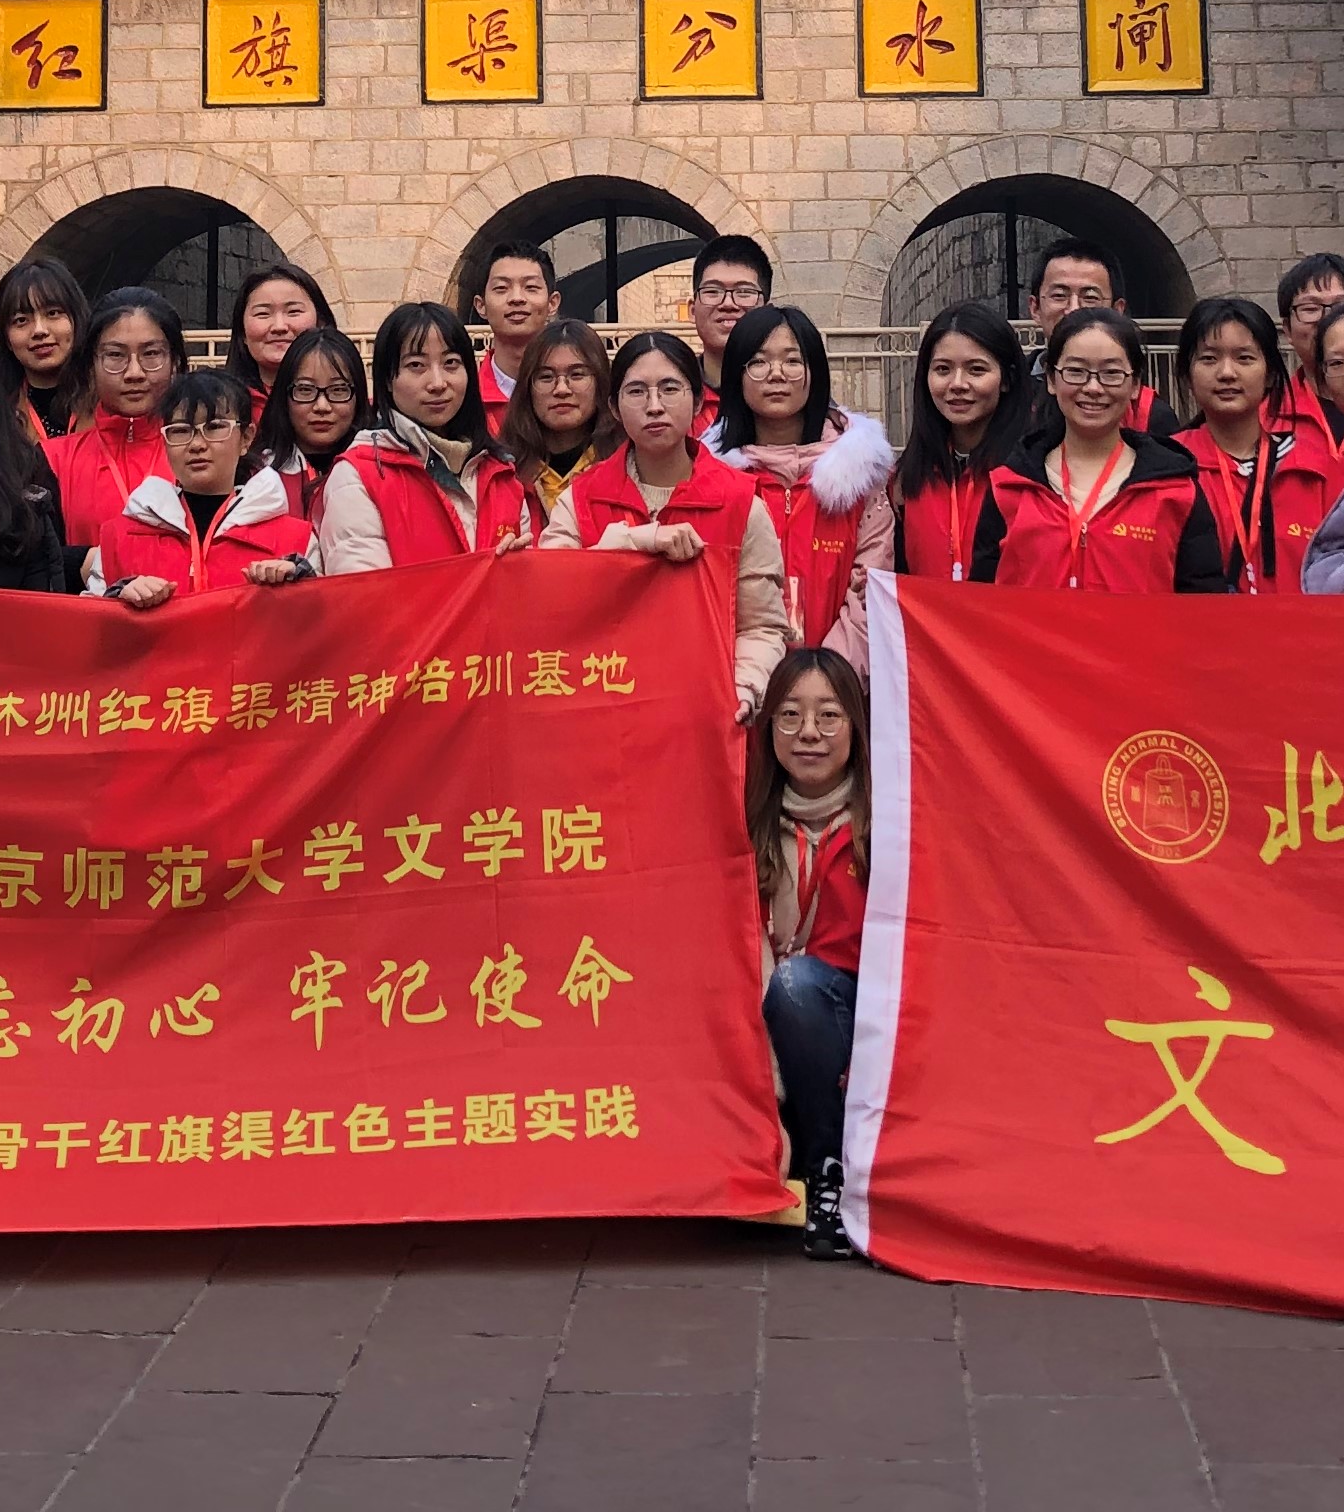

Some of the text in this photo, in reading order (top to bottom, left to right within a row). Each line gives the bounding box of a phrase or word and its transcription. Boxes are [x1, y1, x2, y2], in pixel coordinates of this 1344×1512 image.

[1108, 736, 1223, 837] BEIJING NORMAL UNIVERSITY
[288, 934, 635, 1049] 牢记使命
